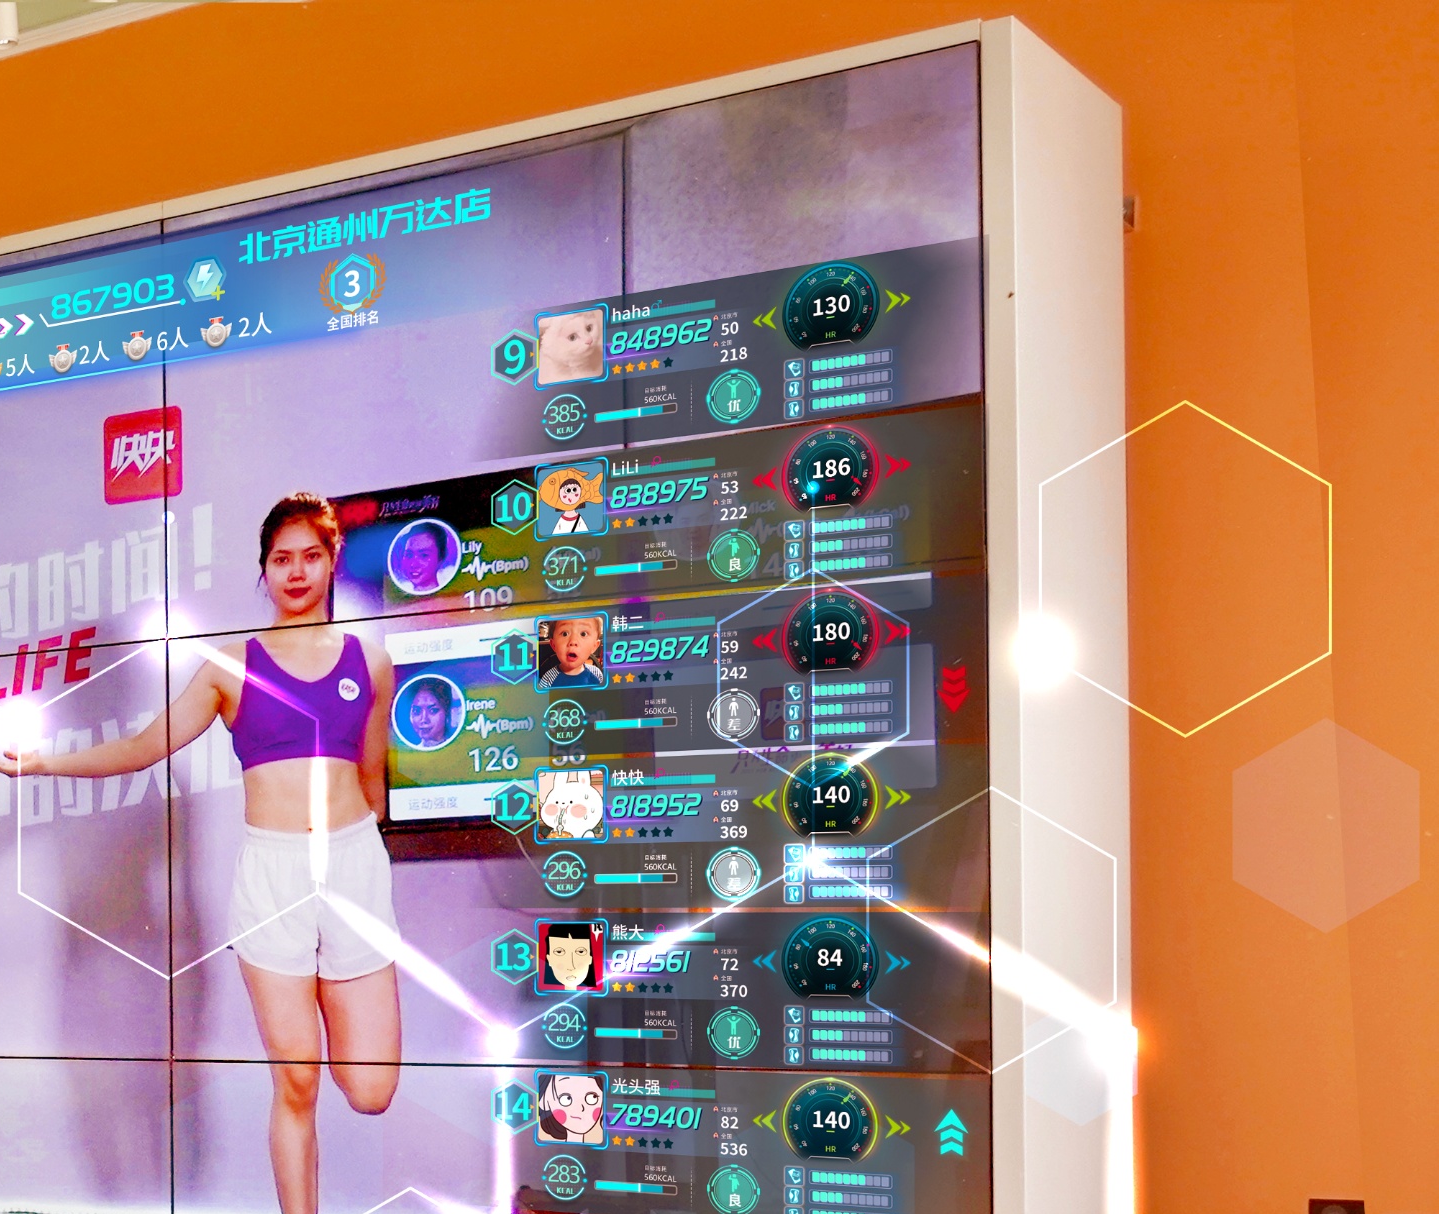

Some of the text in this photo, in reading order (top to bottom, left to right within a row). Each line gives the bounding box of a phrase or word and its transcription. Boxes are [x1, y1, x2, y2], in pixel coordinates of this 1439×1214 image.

[238, 187, 491, 265] 北京通州万达店
[343, 269, 361, 298] 3
[51, 274, 175, 320] 867903
[812, 295, 851, 317] 130
[327, 310, 379, 332] 全国排名
[612, 304, 651, 322] haha
[238, 312, 273, 338] 2人
[720, 322, 739, 336] 50
[156, 327, 188, 351] 6人
[610, 319, 713, 355] 848962
[79, 341, 110, 365] 2人
[504, 340, 525, 374] 9
[720, 347, 748, 362] 218
[6, 354, 35, 377] 5人
[644, 393, 677, 404] 560KCAL
[548, 403, 580, 425] 385
[612, 459, 639, 477] LiLi
[812, 457, 851, 479] 186
[610, 476, 709, 510] 838975
[721, 480, 739, 494] 53
[496, 492, 531, 523] 10
[720, 506, 748, 521] 222
[462, 541, 482, 555] Lily
[644, 550, 677, 559] 560KCAL
[491, 556, 529, 574] (Bpm)
[548, 556, 579, 576] 371
[728, 557, 742, 572] 良
[463, 586, 514, 613] 109
[612, 615, 644, 632] 韩二
[812, 622, 851, 642] 180
[498, 642, 533, 671] 11
[610, 635, 710, 665] 829874
[721, 641, 739, 654] 59
[720, 666, 748, 681] 242
[466, 699, 496, 712] Irene
[644, 707, 677, 716] 560KCAL
[496, 716, 534, 733] (Bpm)
[548, 709, 581, 729] 368
[468, 745, 519, 772] 126
[612, 769, 644, 786] 快快
[812, 786, 851, 804] 140
[496, 793, 531, 821] 12
[610, 793, 702, 818] 818952
[721, 799, 739, 813] 69
[720, 825, 748, 839] 369
[548, 861, 581, 880] 296
[644, 863, 677, 871] 560KCAL
[612, 924, 644, 941] 熊大
[496, 943, 531, 971] 13
[610, 950, 691, 974] 812561
[721, 958, 739, 971] 72
[817, 949, 843, 967] 84
[720, 984, 748, 998] 370
[548, 1013, 581, 1032] 294
[644, 1018, 677, 1027] 560KCAL
[612, 1078, 661, 1096] 光头强
[496, 1092, 531, 1121] 14
[610, 1103, 702, 1130] 789401
[721, 1116, 739, 1130] 82
[812, 1110, 851, 1130] 140
[720, 1143, 748, 1157] 536
[548, 1165, 580, 1184] 283
[644, 1173, 677, 1183] 560KCAL
[728, 1193, 742, 1207] 良
